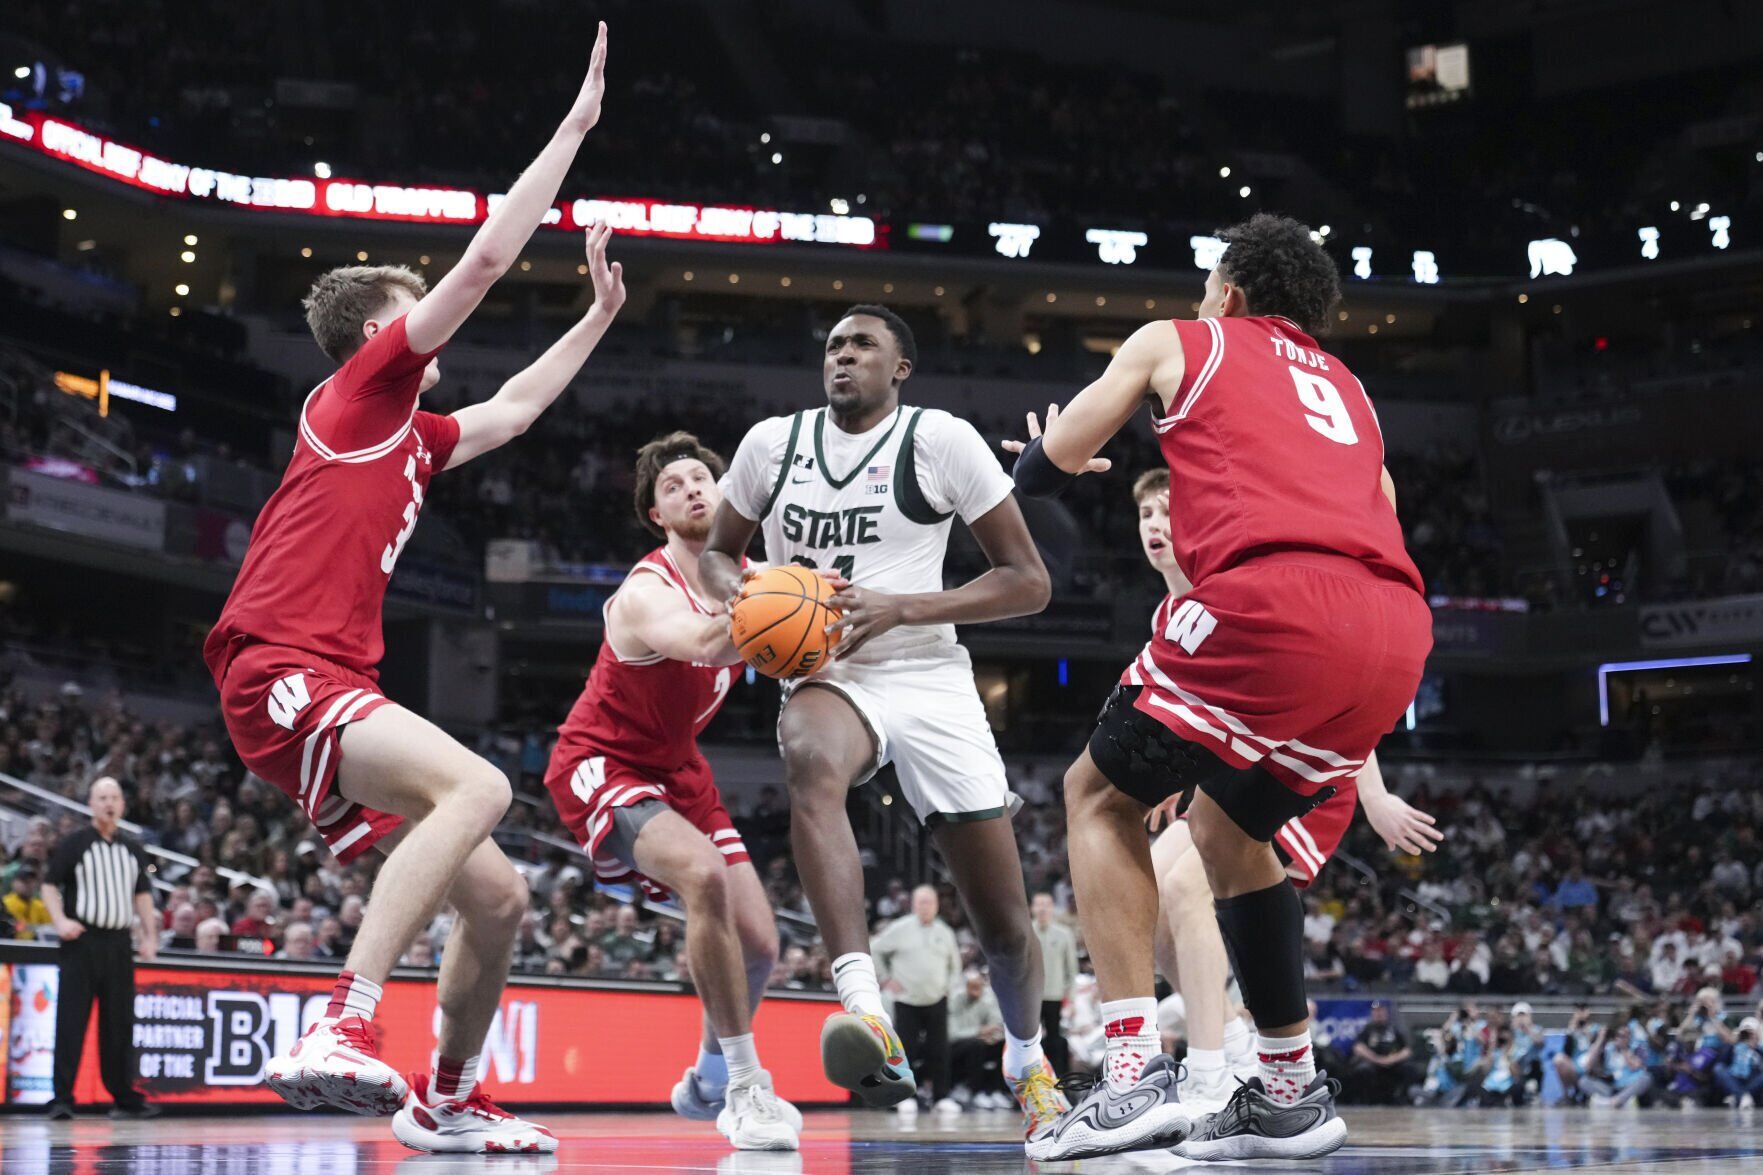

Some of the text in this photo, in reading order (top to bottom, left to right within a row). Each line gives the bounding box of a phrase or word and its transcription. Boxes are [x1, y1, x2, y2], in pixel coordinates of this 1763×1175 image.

[1270, 336, 1330, 371] TONJE
[1288, 365, 1359, 446] 9
[782, 502, 885, 550] STATE
[1164, 600, 1218, 656] W
[267, 672, 312, 731] W
[694, 667, 731, 723] 7
[570, 756, 607, 805] W
[134, 994, 205, 1020] OFFICIAL
[132, 1023, 204, 1049] PARTNER
[140, 1053, 195, 1078] OF THE
